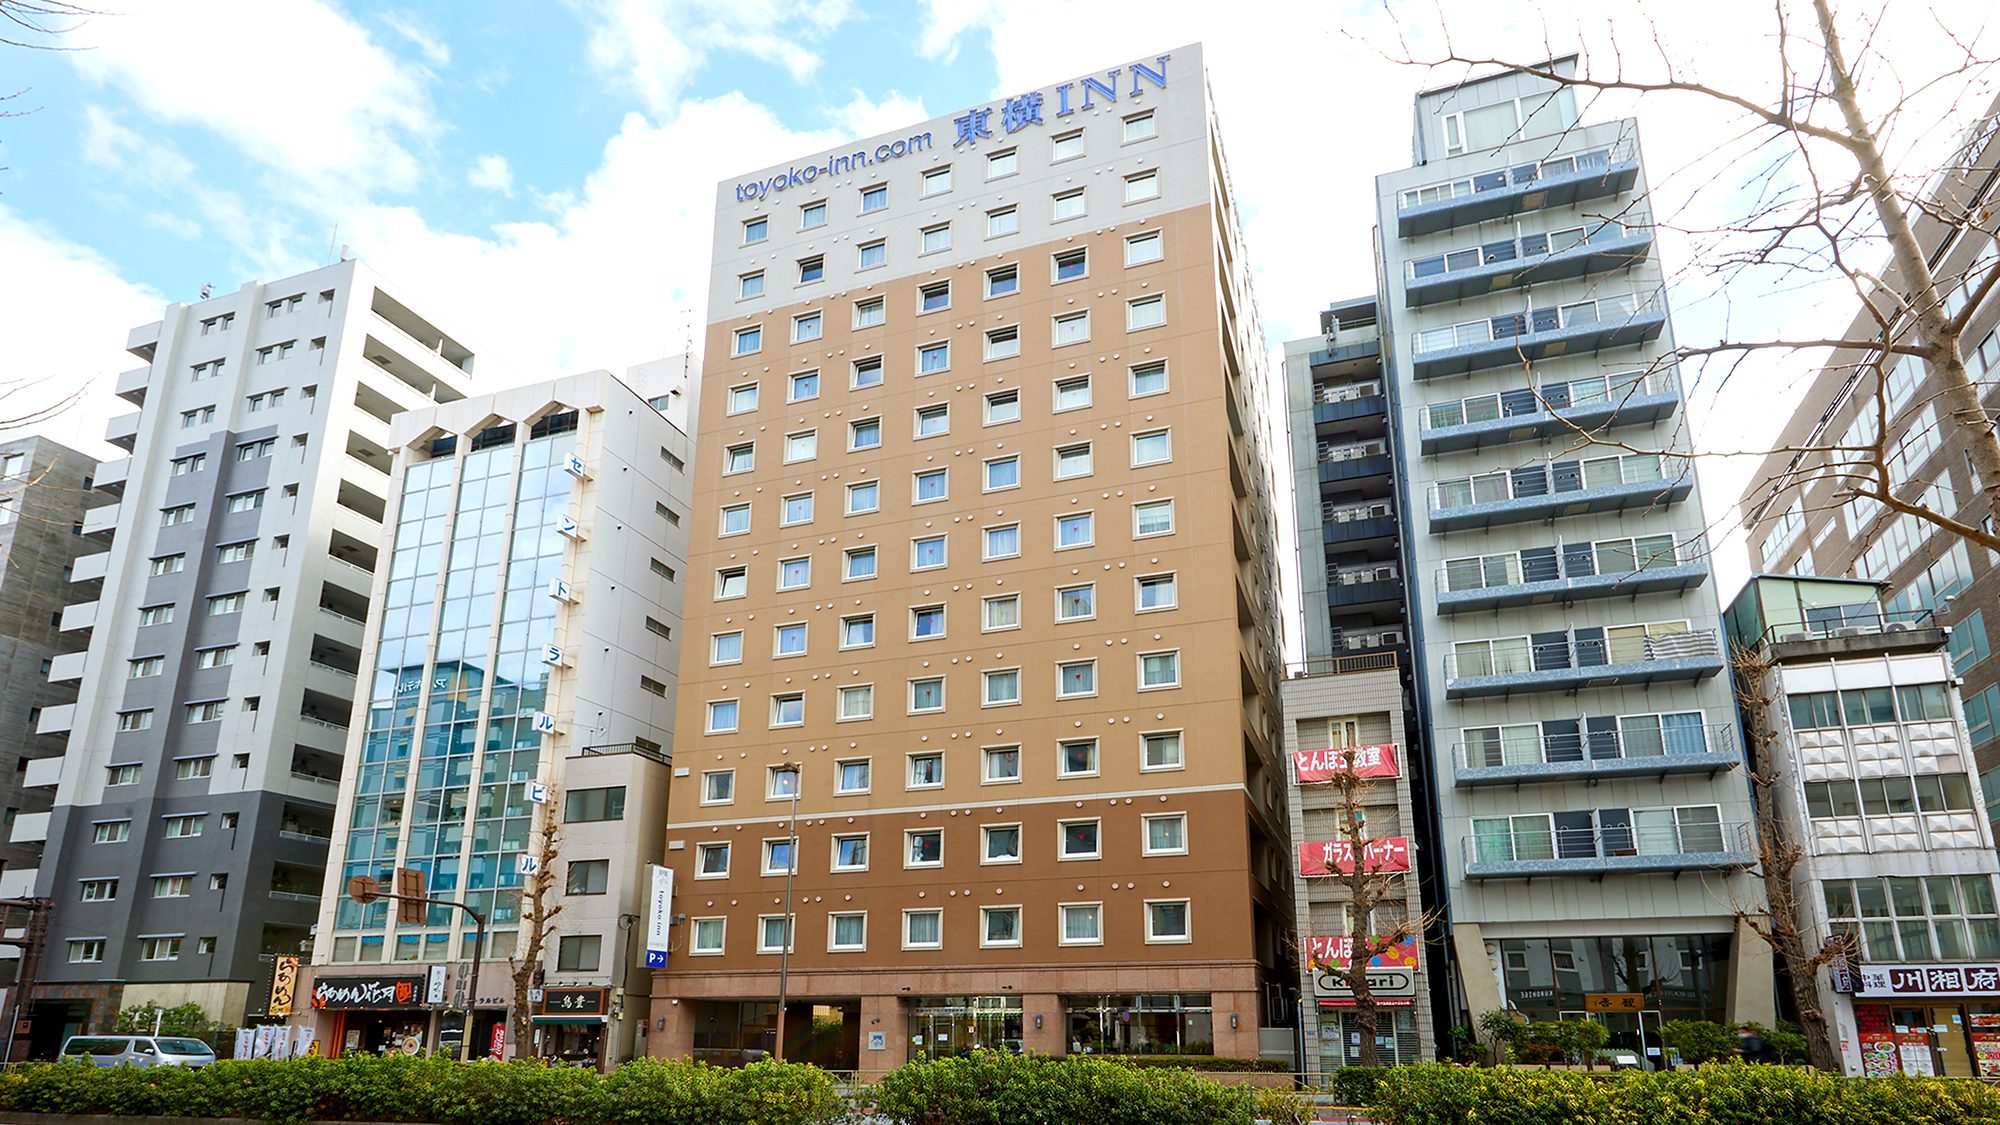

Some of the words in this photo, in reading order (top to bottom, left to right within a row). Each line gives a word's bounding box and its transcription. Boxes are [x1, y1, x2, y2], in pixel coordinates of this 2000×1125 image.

[735, 130, 933, 203] toyoko-inn.com
[649, 953, 656, 963] P
[1332, 976, 1394, 987] Kari
[1892, 969, 1998, 991] 川湘府
